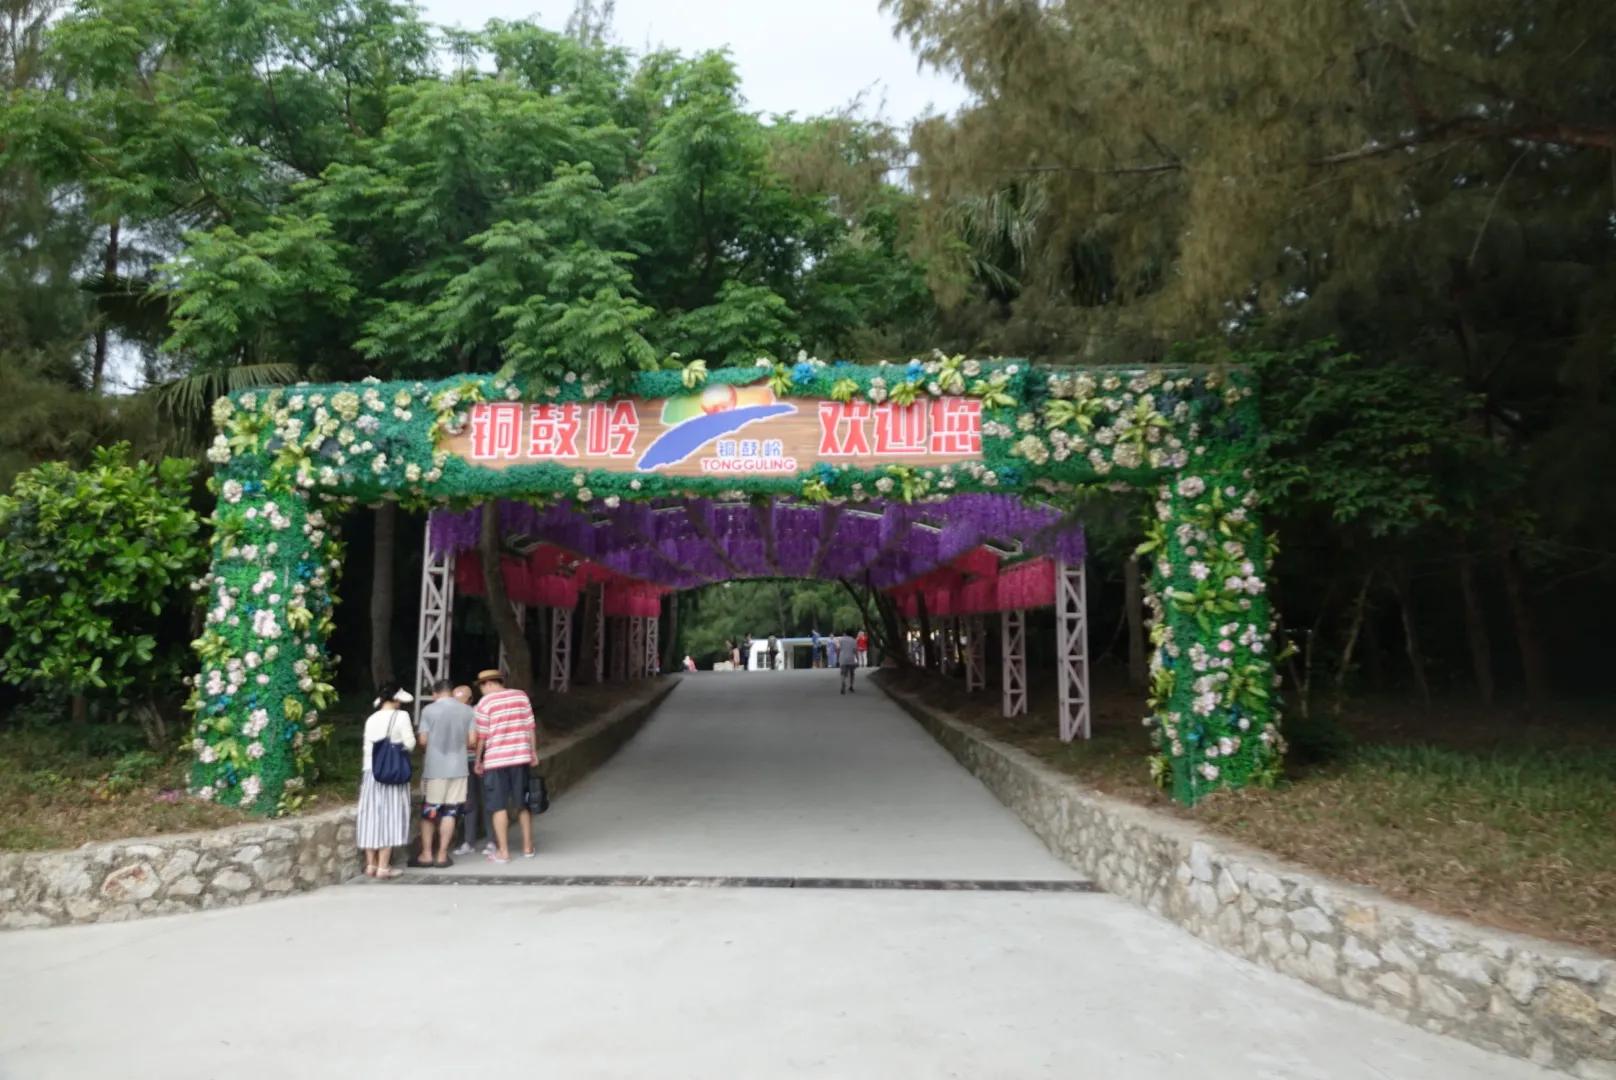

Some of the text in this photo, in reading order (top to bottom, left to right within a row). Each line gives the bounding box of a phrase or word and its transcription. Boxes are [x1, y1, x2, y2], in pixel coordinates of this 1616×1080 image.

[470, 399, 982, 458] 铜鼓岭 欢迎您
[717, 440, 782, 457] 铜鼓岭
[702, 458, 796, 472] TONGGULING
